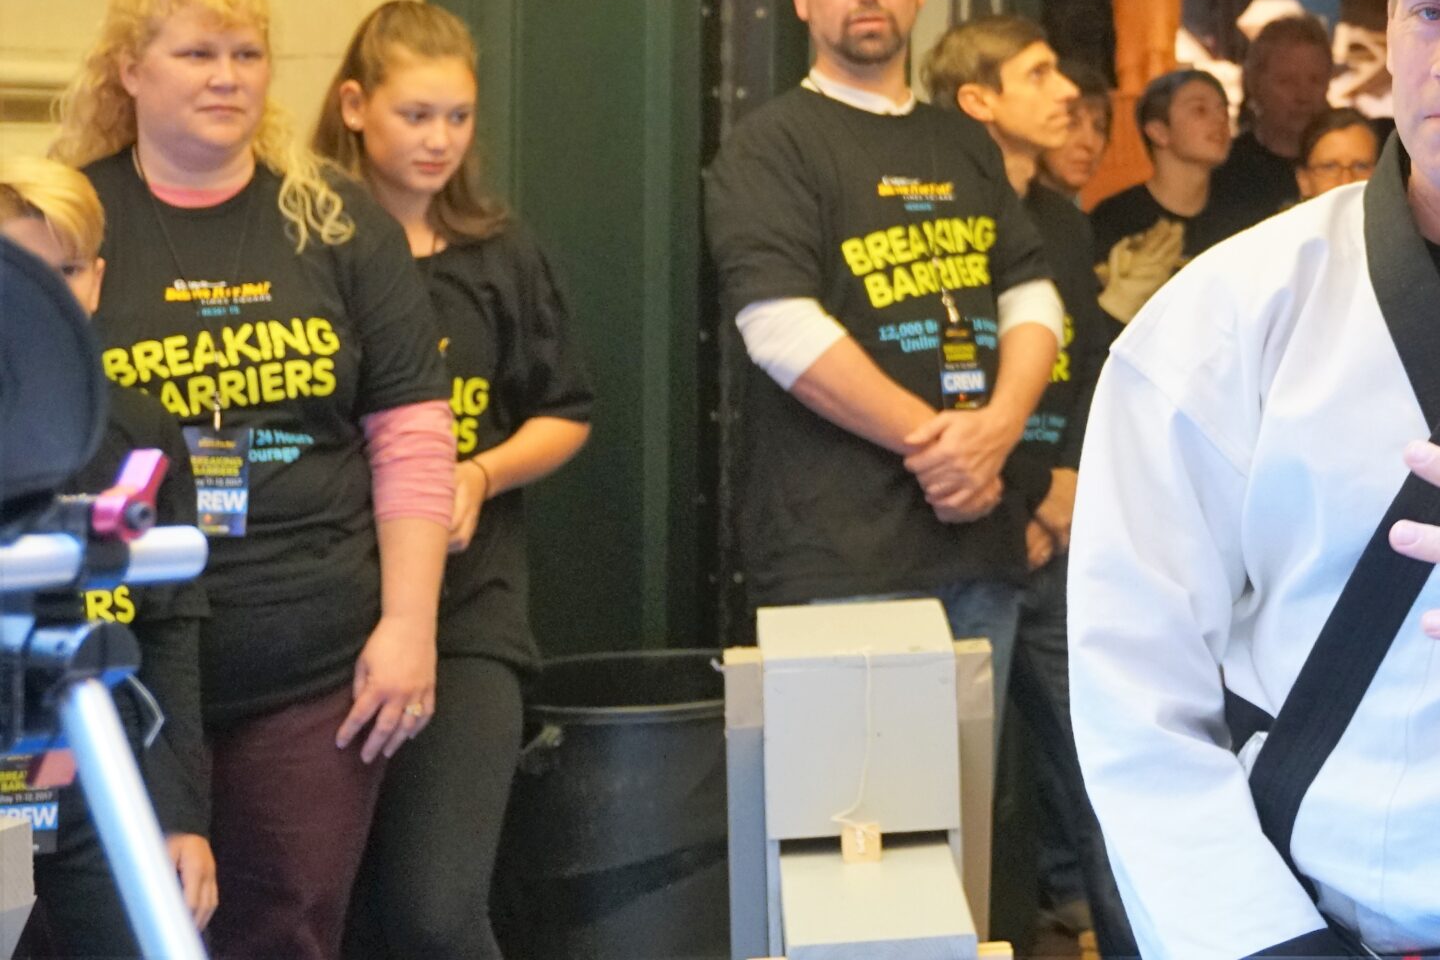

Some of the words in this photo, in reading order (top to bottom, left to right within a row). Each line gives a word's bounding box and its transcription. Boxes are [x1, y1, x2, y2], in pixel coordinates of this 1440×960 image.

[841, 215, 997, 276] BREAKING
[864, 252, 991, 308] BARRIER
[102, 317, 340, 387] BREAKING
[159, 357, 336, 418] ARRIERS
[943, 371, 985, 392] CREW
[248, 447, 301, 464] ourage
[197, 489, 248, 512] REW
